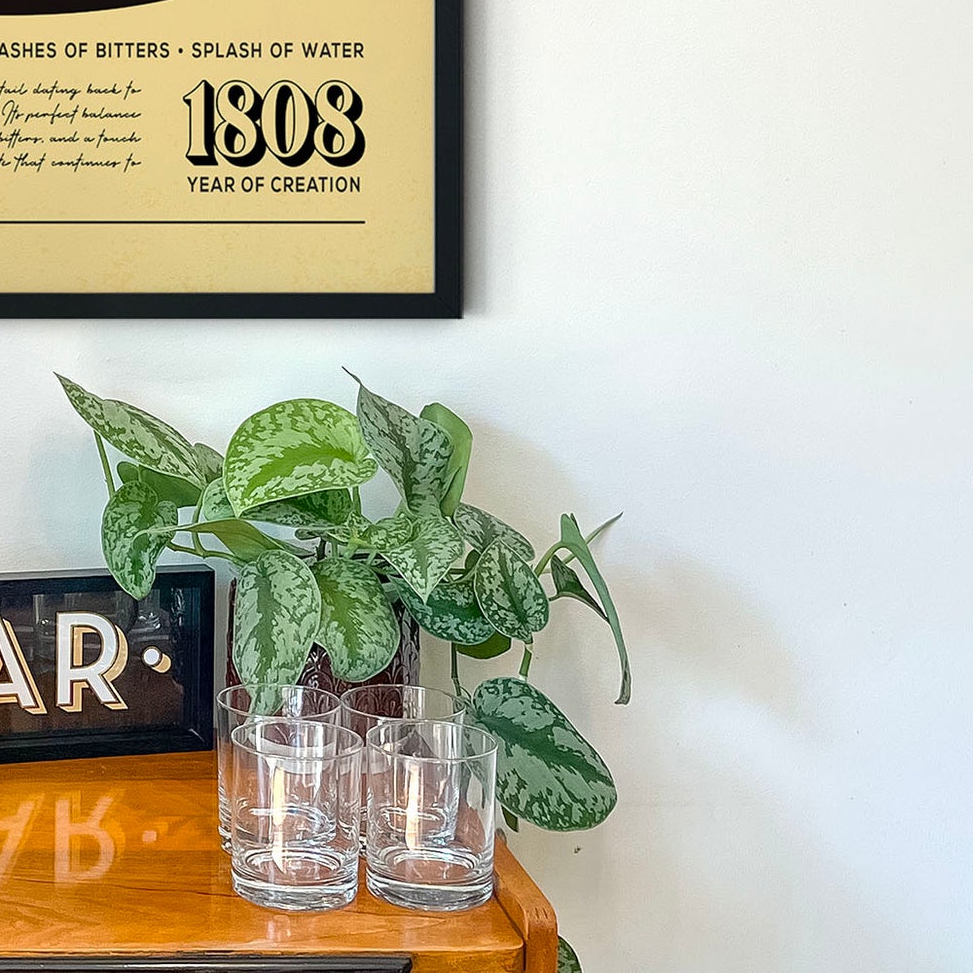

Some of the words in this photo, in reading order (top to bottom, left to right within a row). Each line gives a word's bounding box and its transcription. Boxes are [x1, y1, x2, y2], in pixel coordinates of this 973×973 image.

[64, 42, 88, 58] OF
[96, 42, 170, 58] BITTERS
[191, 42, 262, 58] SPLASH
[270, 42, 294, 58] OF
[301, 42, 365, 58] WATER
[32, 80, 81, 100] dating
[86, 83, 122, 95] back
[123, 80, 142, 100] to
[1, 100, 25, 126] Its
[24, 103, 80, 124] perfect
[82, 107, 142, 119] balance
[182, 79, 366, 168] 1808
[49, 131, 80, 143] and
[96, 129, 142, 149] touch
[13, 153, 46, 173] that
[51, 153, 122, 173] continues
[123, 153, 142, 173] to
[186, 176, 235, 193] YEAR
[240, 176, 265, 193] OF
[270, 176, 361, 193] CREATION
